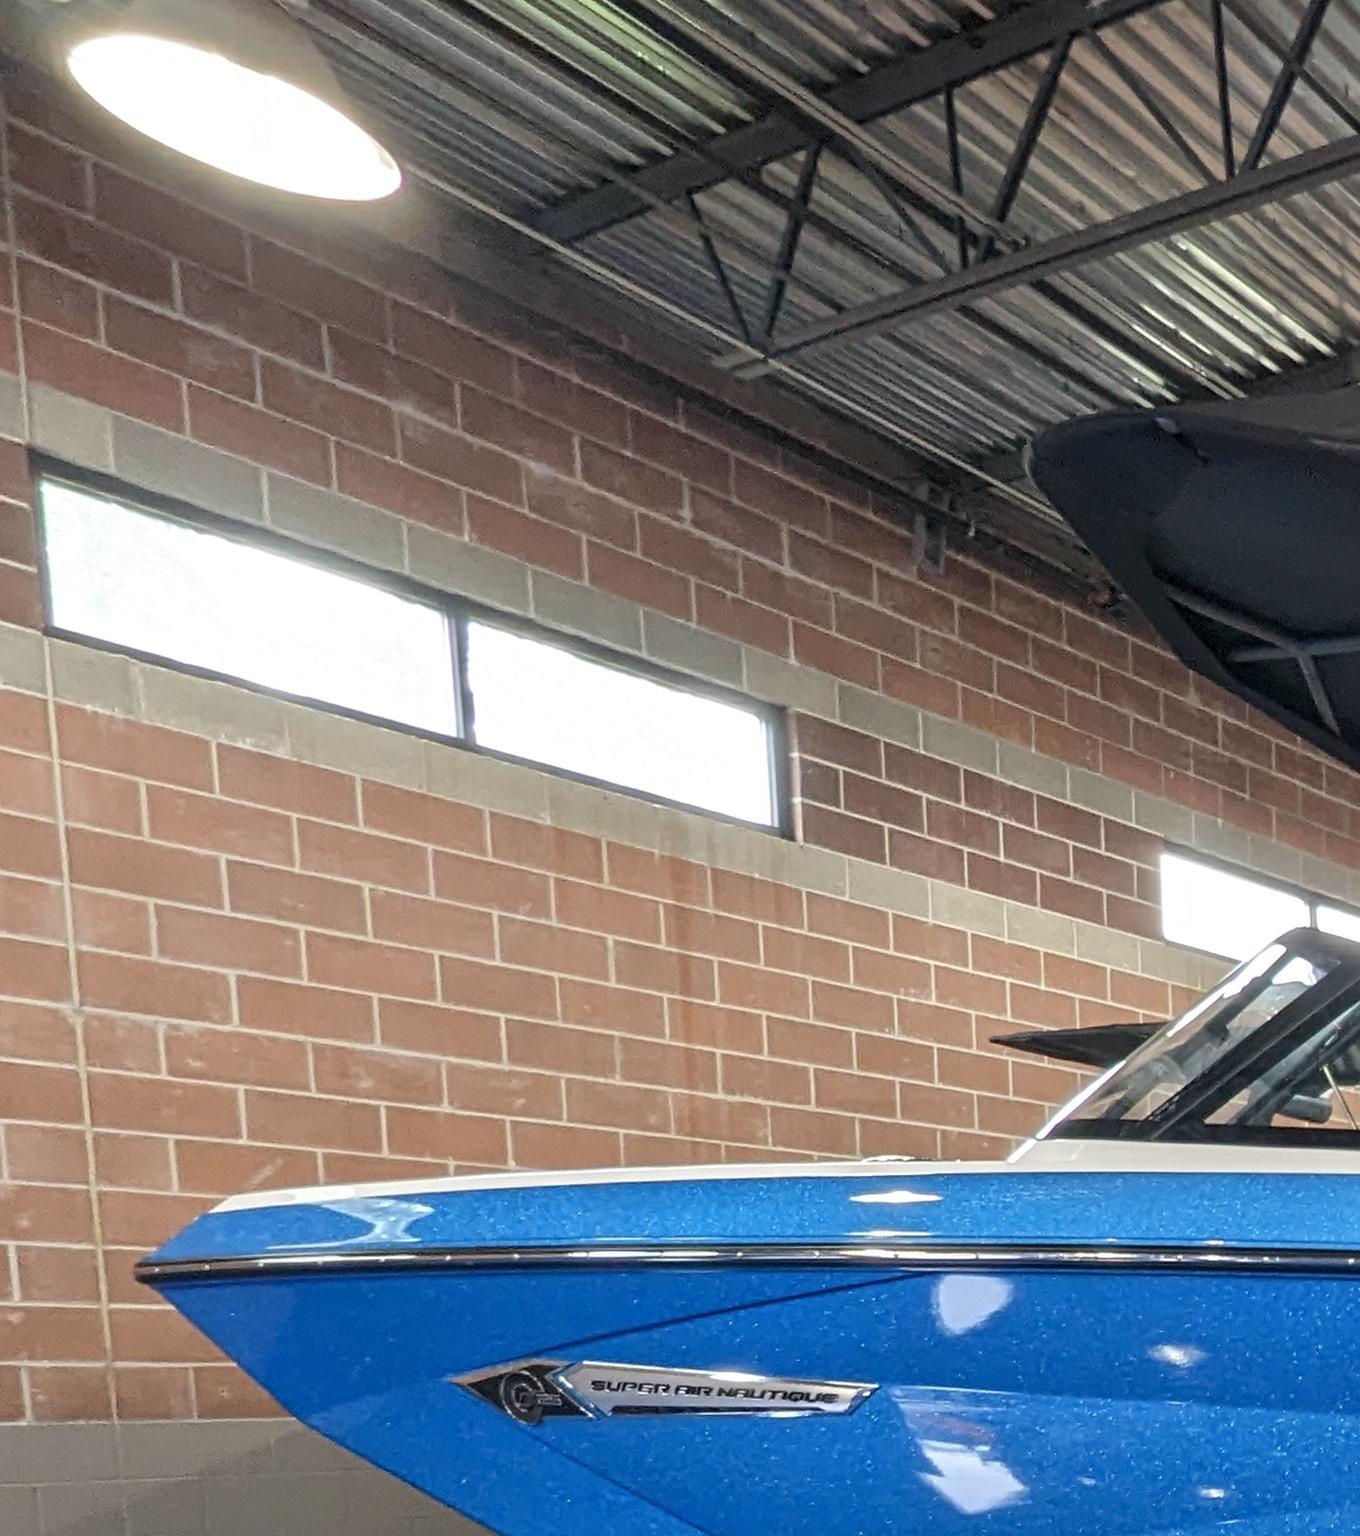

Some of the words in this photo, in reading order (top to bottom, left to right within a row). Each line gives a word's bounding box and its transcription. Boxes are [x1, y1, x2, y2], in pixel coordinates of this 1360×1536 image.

[591, 1380, 671, 1395] SUPER
[674, 1384, 714, 1397] AIR
[717, 1386, 840, 1404] NAUTIQUE
